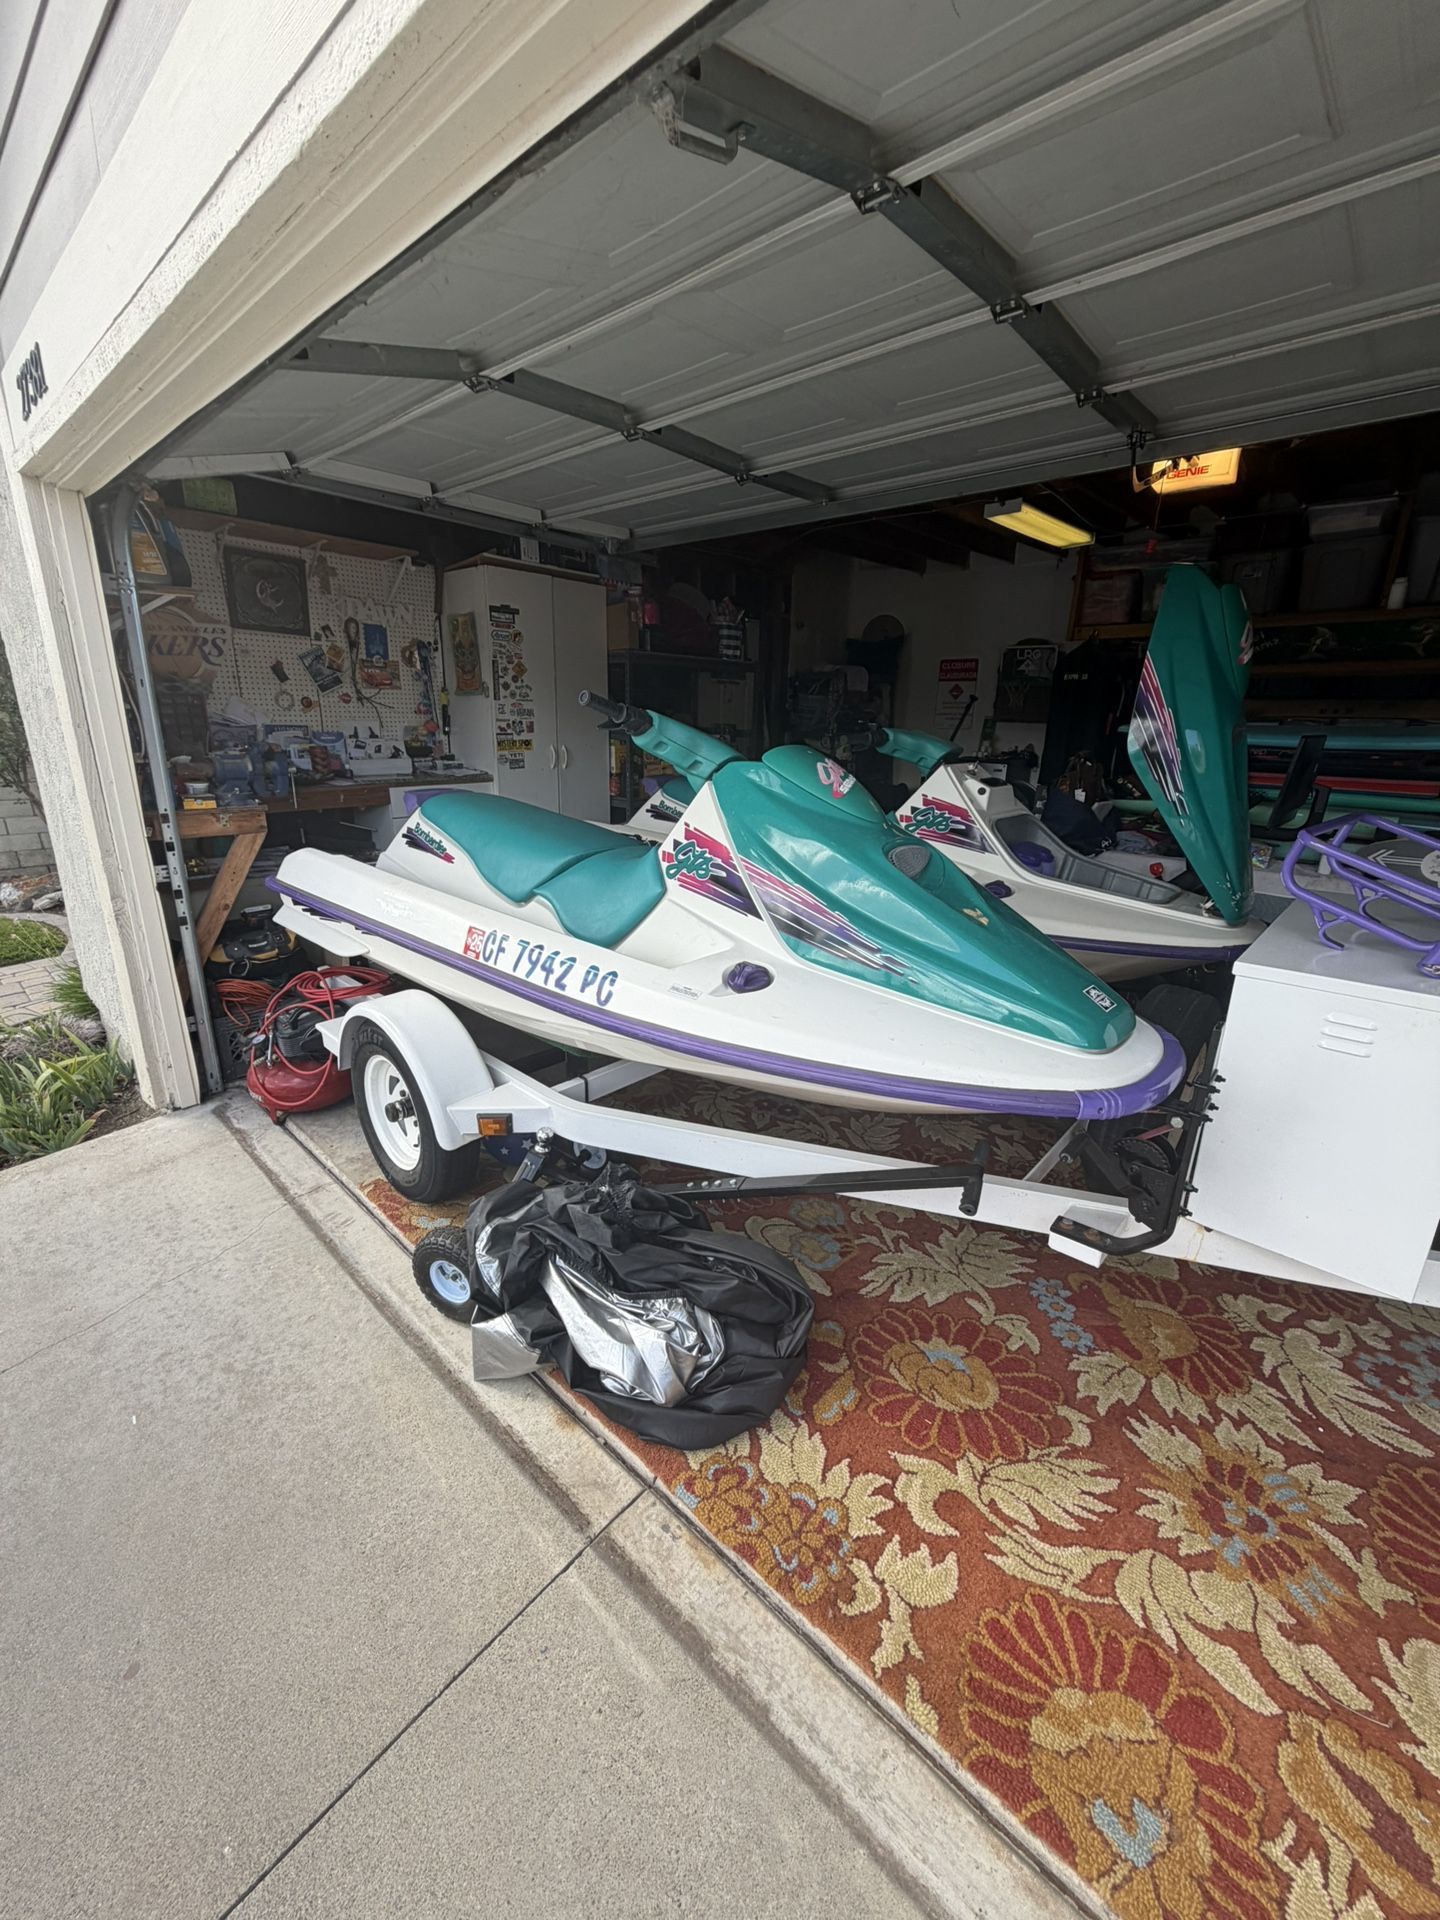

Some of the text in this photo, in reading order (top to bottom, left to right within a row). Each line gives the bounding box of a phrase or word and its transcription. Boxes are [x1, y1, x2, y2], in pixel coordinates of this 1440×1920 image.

[1166, 465, 1210, 479] GENIE
[147, 634, 226, 667] KERS
[1017, 649, 1041, 660] LRG
[482, 929, 619, 1007] CF 7942 PC
